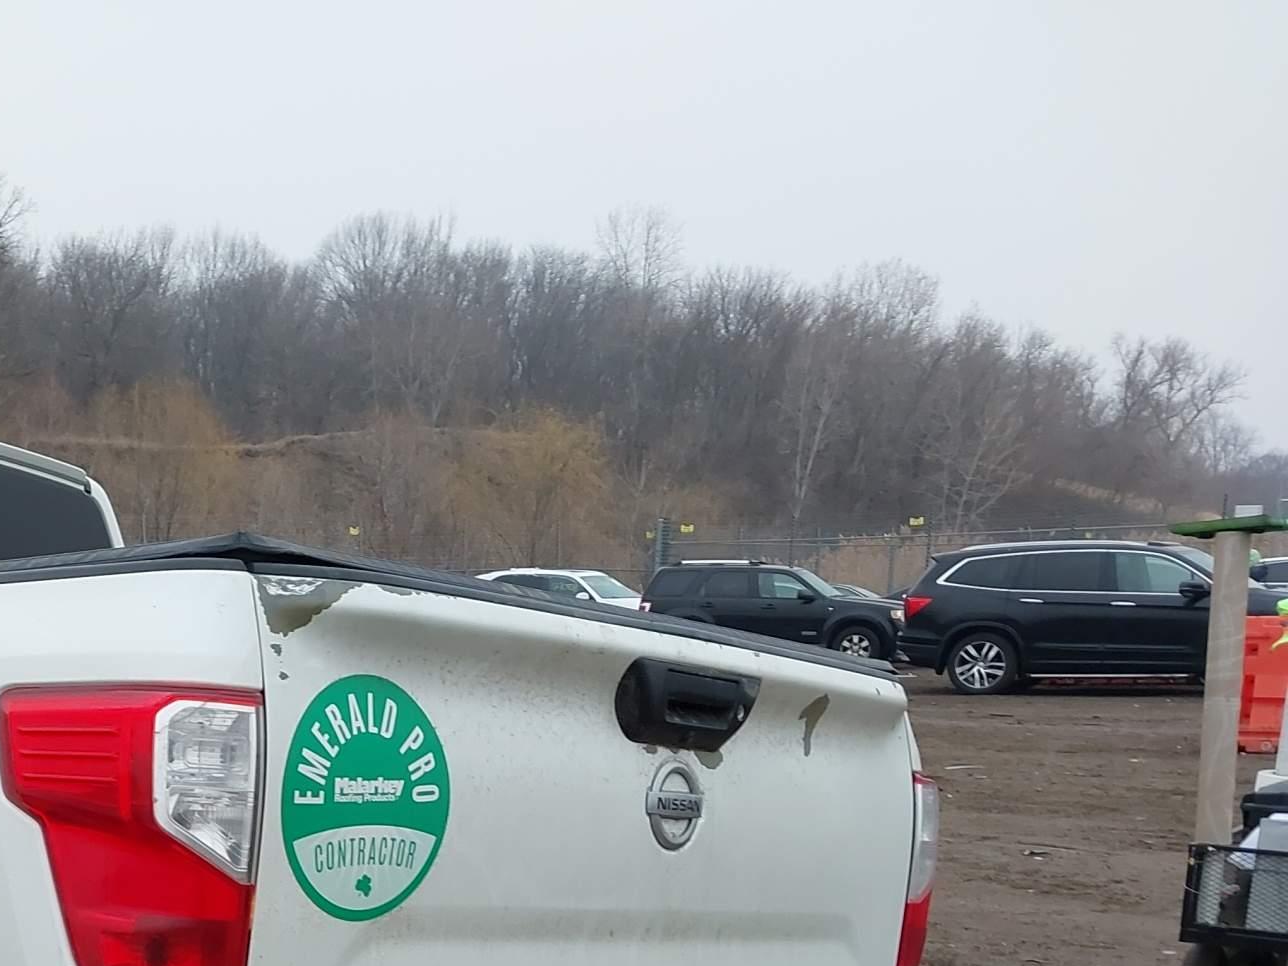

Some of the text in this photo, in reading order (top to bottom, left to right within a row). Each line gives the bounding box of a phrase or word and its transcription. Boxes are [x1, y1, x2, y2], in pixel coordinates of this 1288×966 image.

[293, 692, 440, 805] EMERALD PRO
[657, 797, 701, 813] NISSAN
[314, 837, 417, 873] CONTRACTOR
